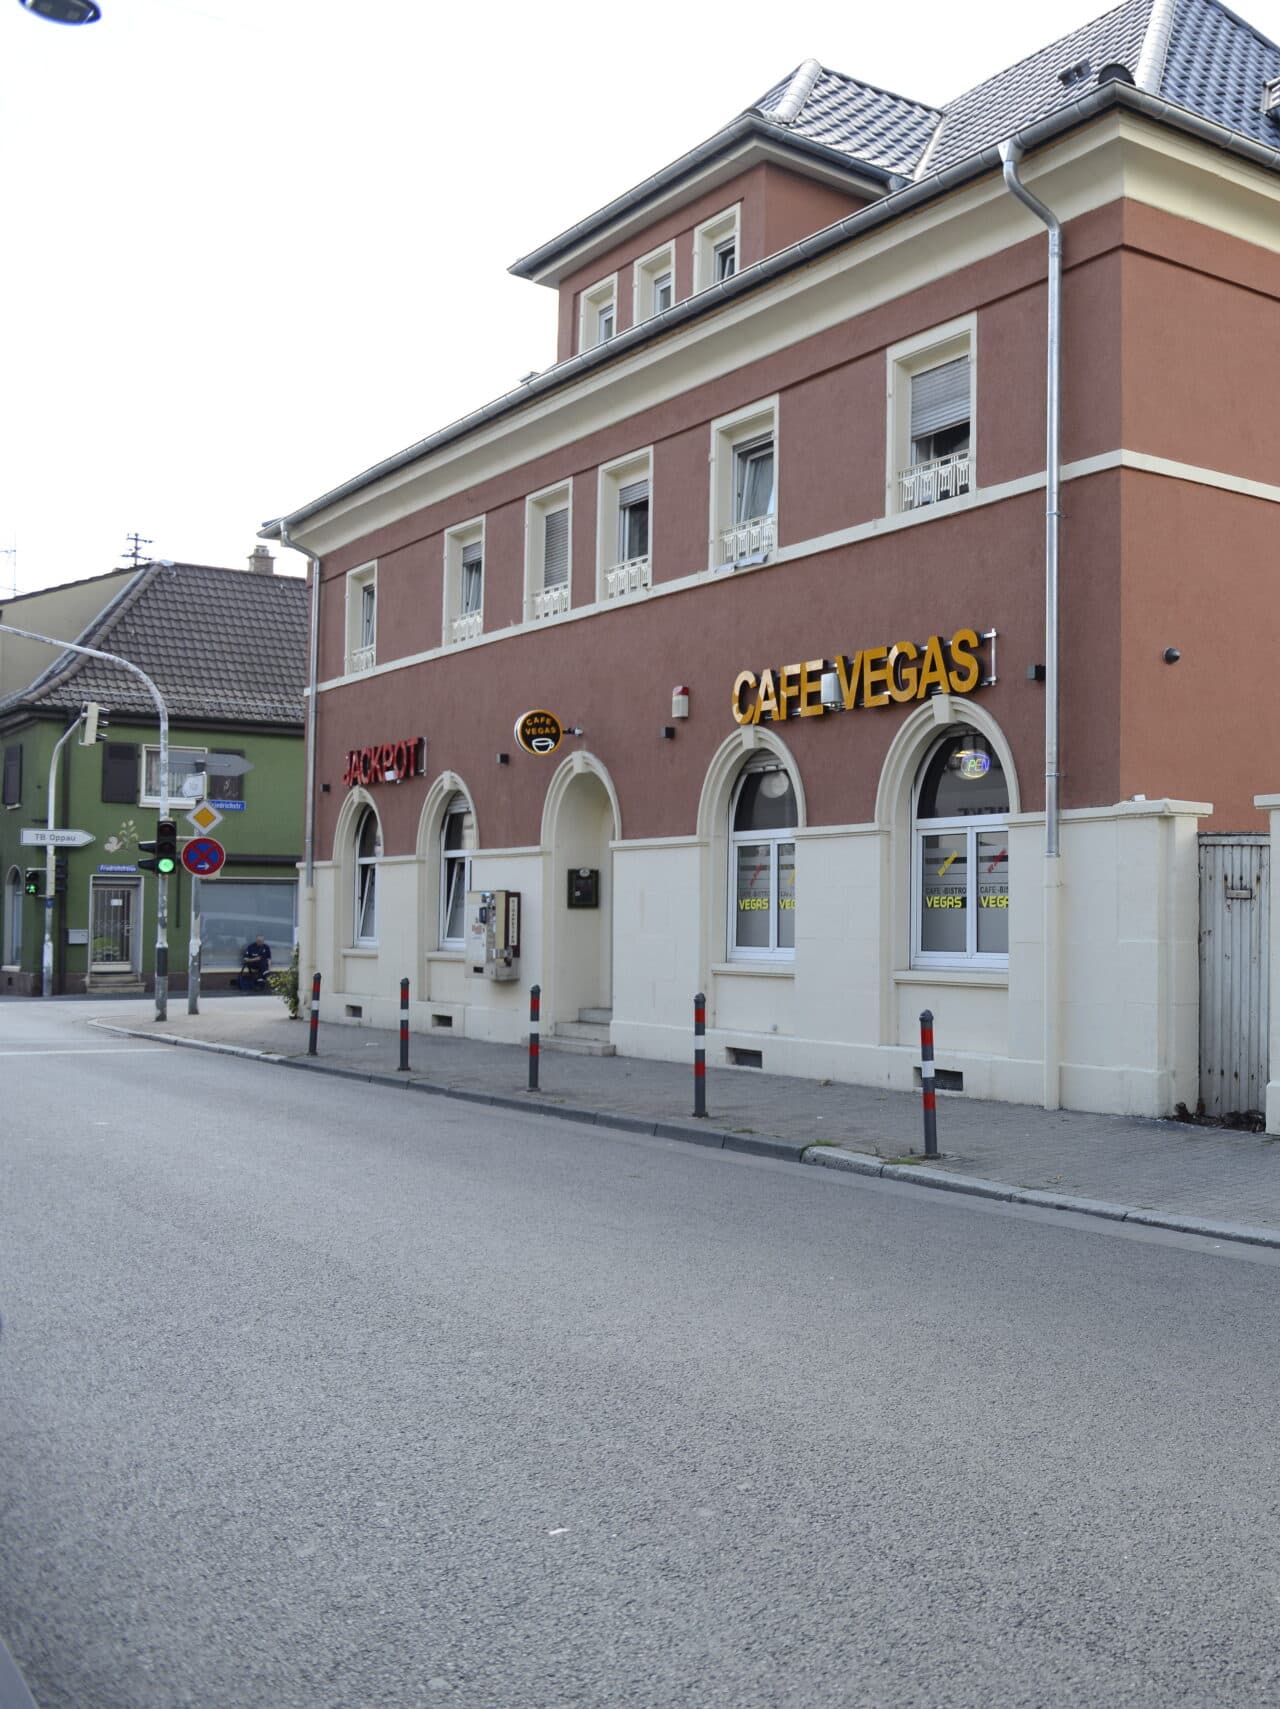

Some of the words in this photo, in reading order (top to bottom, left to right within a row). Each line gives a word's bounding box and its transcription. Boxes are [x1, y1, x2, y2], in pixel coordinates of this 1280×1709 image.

[732, 658, 823, 725] CAFE
[835, 628, 979, 710] VEGAS
[526, 716, 552, 726] CAFE
[525, 726, 557, 735] VEGAS
[342, 737, 419, 788] JACKPOT
[49, 833, 76, 843] Oppau
[739, 898, 769, 910] VEGAS
[926, 896, 962, 909] VEGAS
